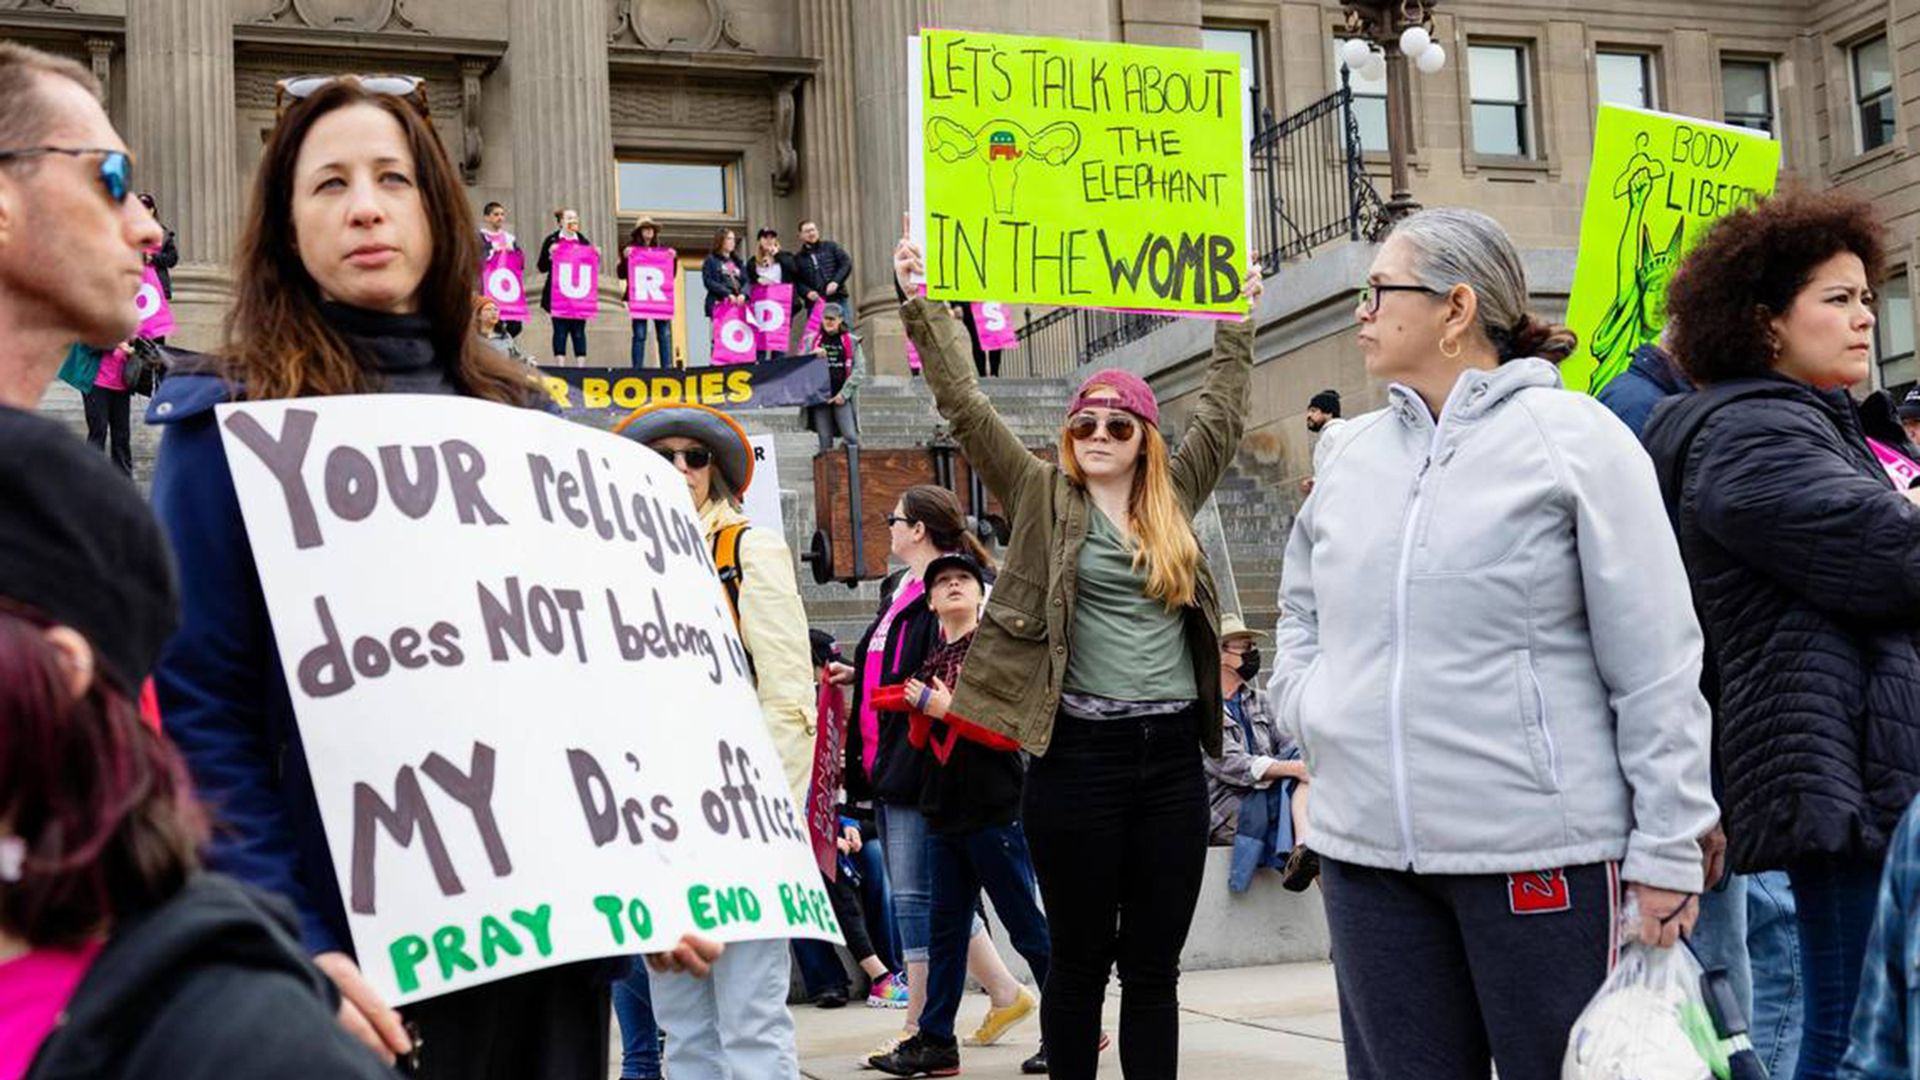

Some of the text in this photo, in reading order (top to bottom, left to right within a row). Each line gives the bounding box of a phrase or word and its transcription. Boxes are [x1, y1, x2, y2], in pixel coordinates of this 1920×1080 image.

[927, 36, 1232, 118] LET'S TALK ABOUT
[1106, 127, 1181, 156] THE
[1672, 125, 1738, 171] BODY
[1082, 160, 1228, 207] ELEPHANT
[1666, 171, 1771, 217] LIBERT
[559, 262, 592, 298] U
[931, 212, 1241, 305] IN THE WOMB
[634, 266, 667, 302] R
[583, 370, 753, 409] BODIES
[224, 408, 715, 576] YOUR religion
[297, 595, 465, 698] does
[477, 576, 588, 663] NOT
[606, 588, 722, 685] belong
[351, 740, 513, 915] MY
[567, 748, 680, 848] Dr's
[389, 882, 839, 994] PRAY TO END RAPE
